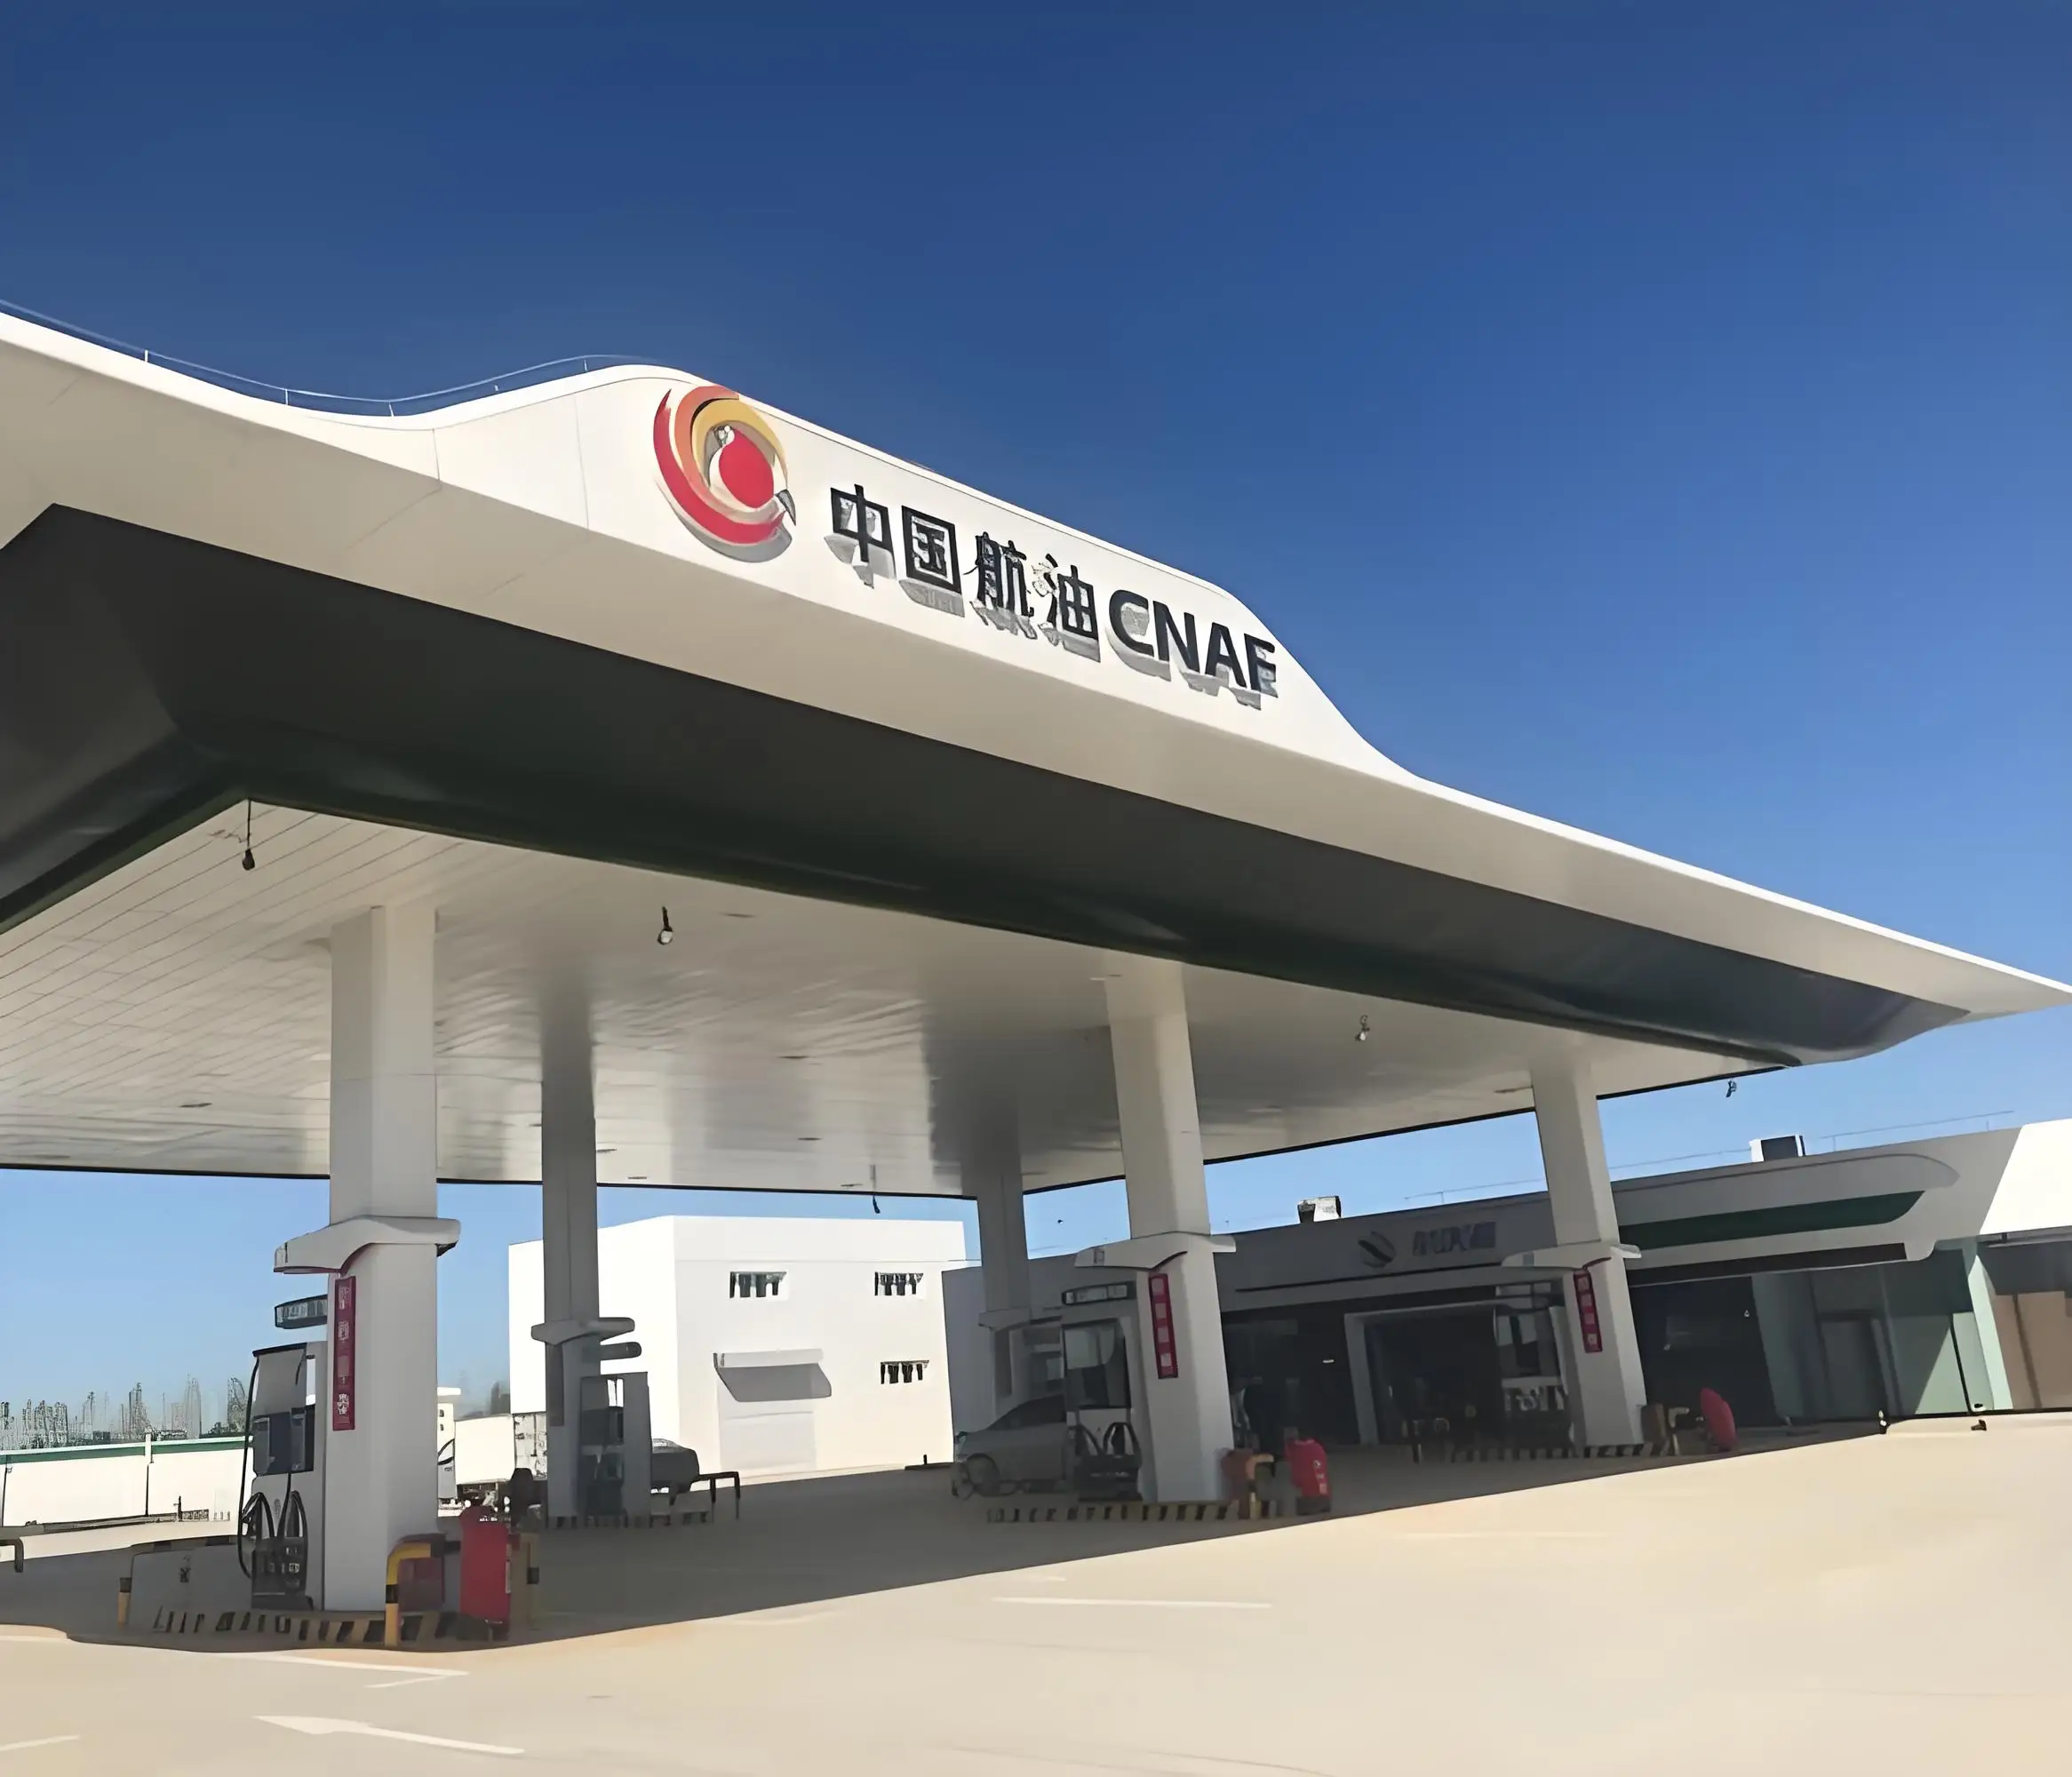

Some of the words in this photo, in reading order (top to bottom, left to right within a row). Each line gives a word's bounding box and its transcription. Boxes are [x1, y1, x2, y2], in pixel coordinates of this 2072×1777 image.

[831, 484, 1098, 640] 中国航油
[1109, 590, 1277, 693] CNAF
